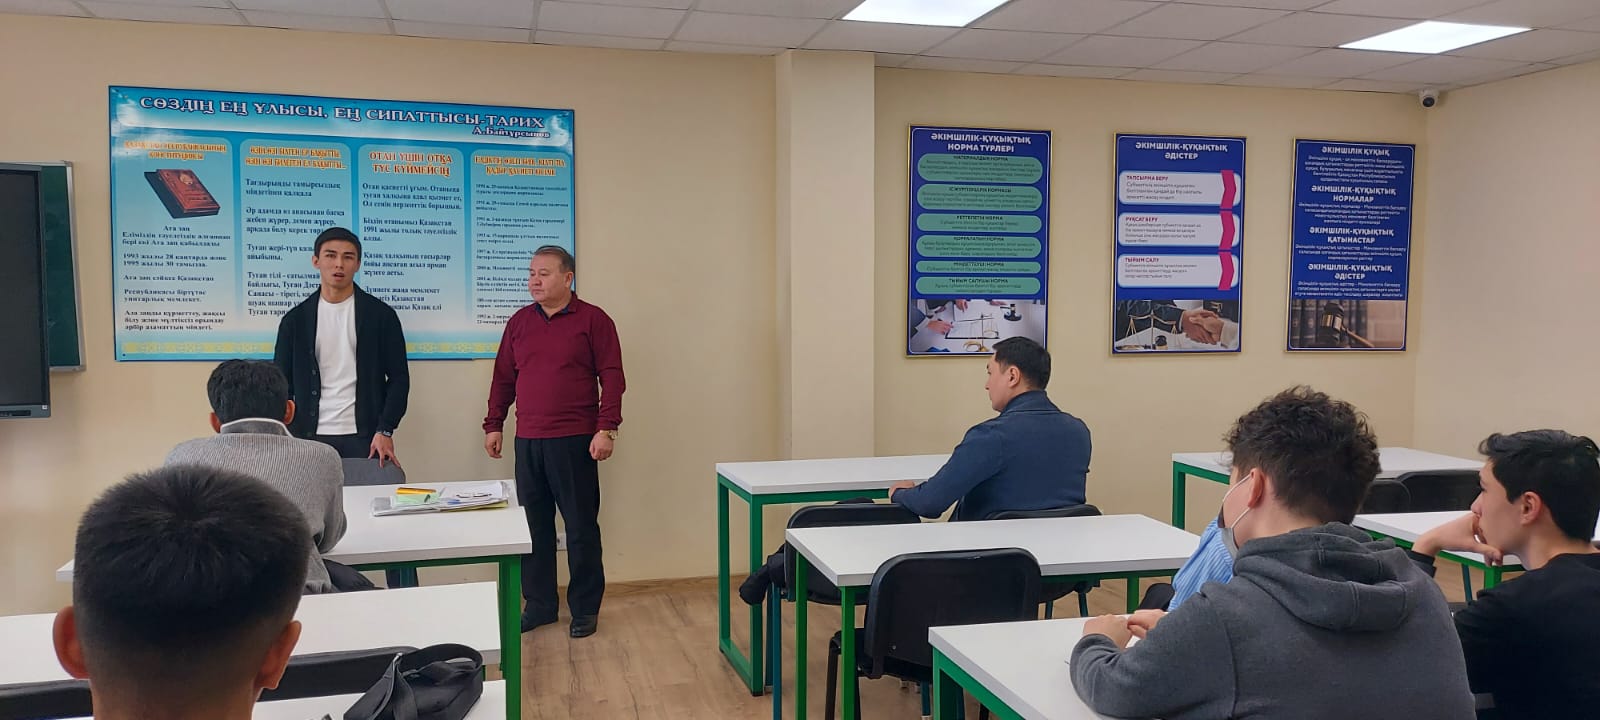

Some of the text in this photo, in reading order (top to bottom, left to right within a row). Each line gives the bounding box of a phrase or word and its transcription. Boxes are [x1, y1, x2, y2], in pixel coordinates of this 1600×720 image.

[140, 97, 546, 129] СӨЗДІҢ ЕҢ ҰЛЫСЫ, ЕҢ СИПАТТЫСЫ-ТАРИХ
[930, 133, 1031, 144] ӘКІМШІЛІК-ҚҰҚЫҚТЫҚ
[947, 143, 1014, 152] НОРМА ТҮРЛЕРІ
[1136, 142, 1228, 152] ӘКІМШІЛІК-ҚҰҚЫҚТЫҚ
[1322, 146, 1390, 157] ӘКІМШІЛІК ҚҰҚЫҚ
[369, 151, 452, 164] ОТАН ҮШІН ОТҚА
[1164, 152, 1198, 160] ӘДІСТЕР
[372, 163, 451, 178] ТҮС КҮЙМЕЙСІҢ
[362, 182, 380, 190] Отан
[1312, 186, 1396, 196] ӘКІМШІЛІК-ҚҰҚЫҚТЫҚ
[419, 218, 452, 227] Қазақстан
[1310, 227, 1394, 236] ӘКІМШІЛІК-ҚҰҚЫҚТЫҚ
[1328, 236, 1376, 244] ҚАТЫНАСТАР
[247, 244, 268, 252] Туған
[1308, 264, 1392, 272] ӘКІМШІЛІК-ҚҰҚЫҚТЫҚ
[248, 272, 268, 280] Туған
[248, 308, 268, 316] Туған
